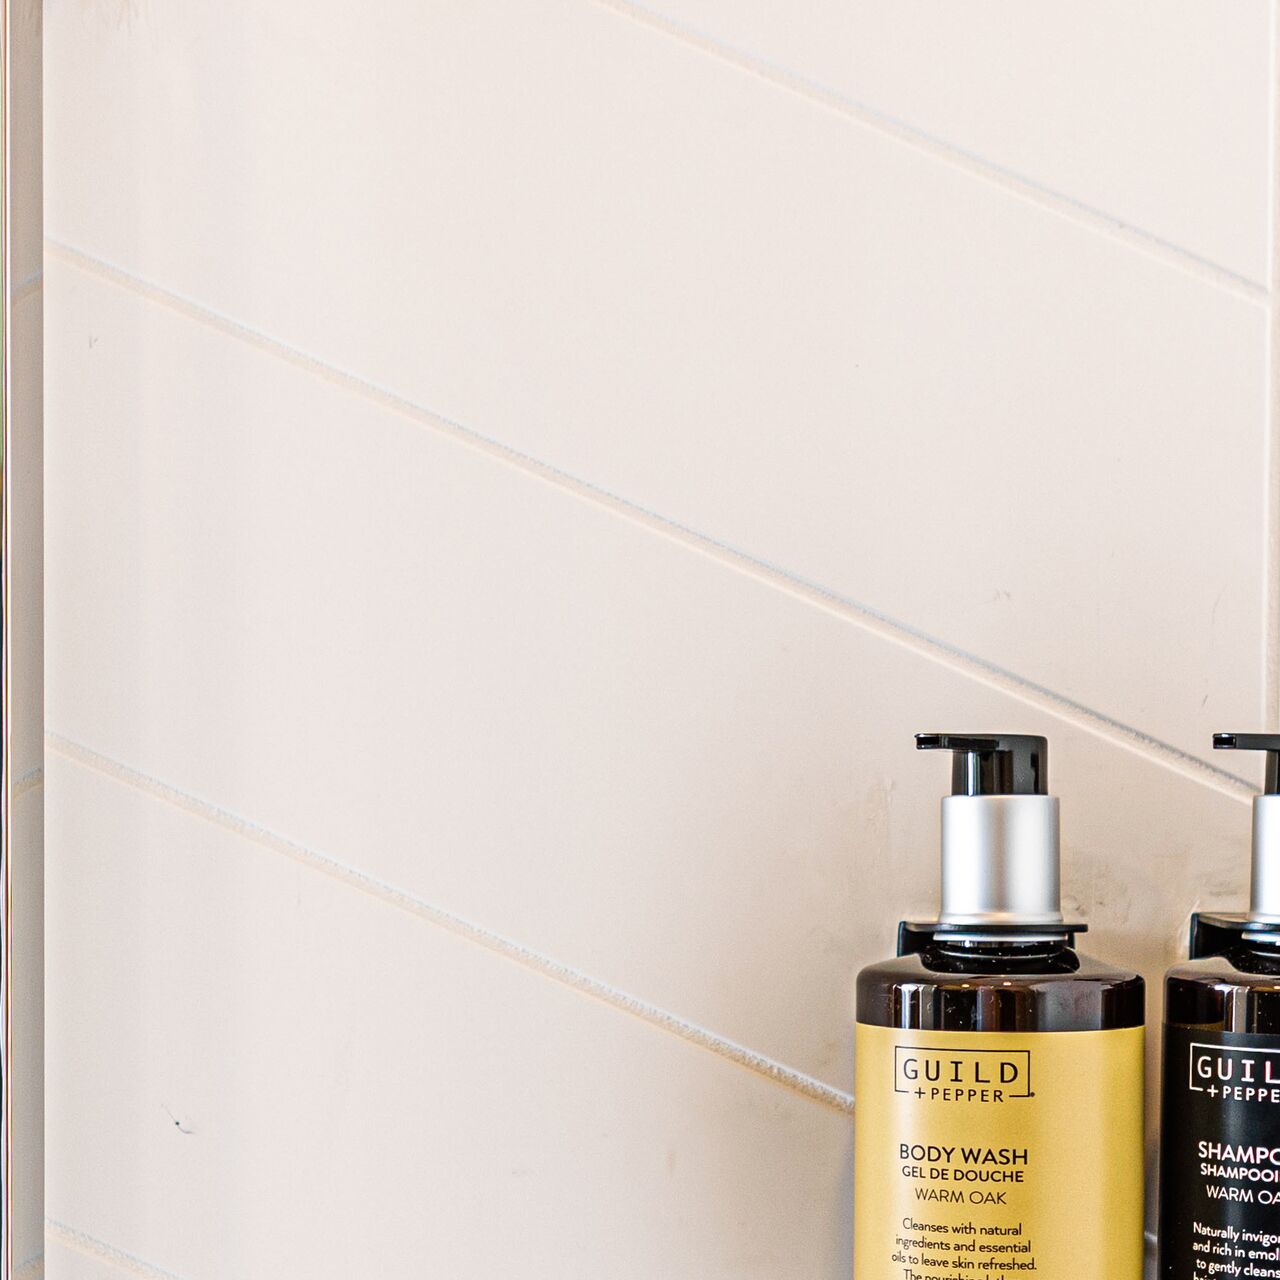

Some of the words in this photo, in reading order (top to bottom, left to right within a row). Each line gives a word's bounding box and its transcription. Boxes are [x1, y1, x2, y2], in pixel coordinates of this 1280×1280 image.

[903, 1058, 1018, 1083] GUILD
[900, 1144, 956, 1163] BODY
[961, 1148, 1028, 1165] WASH
[902, 1166, 926, 1179] GEL
[930, 1168, 949, 1180] DE
[953, 1169, 1024, 1182] DOUCHE
[915, 1188, 965, 1203] WARM
[969, 1190, 1007, 1205] OAK
[1206, 1184, 1254, 1202] WARM
[902, 1218, 949, 1234] Cleanses
[952, 1222, 976, 1235] with
[980, 1223, 1022, 1236] natural
[1193, 1222, 1239, 1241] Naturally
[896, 1235, 950, 1251] ingredients
[953, 1240, 975, 1252] and
[979, 1240, 1031, 1253] essential
[1192, 1240, 1210, 1253] and
[1213, 1243, 1232, 1256] rich
[1234, 1246, 1245, 1258] in
[892, 1251, 906, 1264] oils
[908, 1256, 919, 1265] to
[921, 1254, 949, 1267] leave
[952, 1257, 974, 1269] skin
[978, 1258, 1037, 1270] refreshed.
[1196, 1259, 1206, 1269] to
[1208, 1260, 1241, 1276] gently
